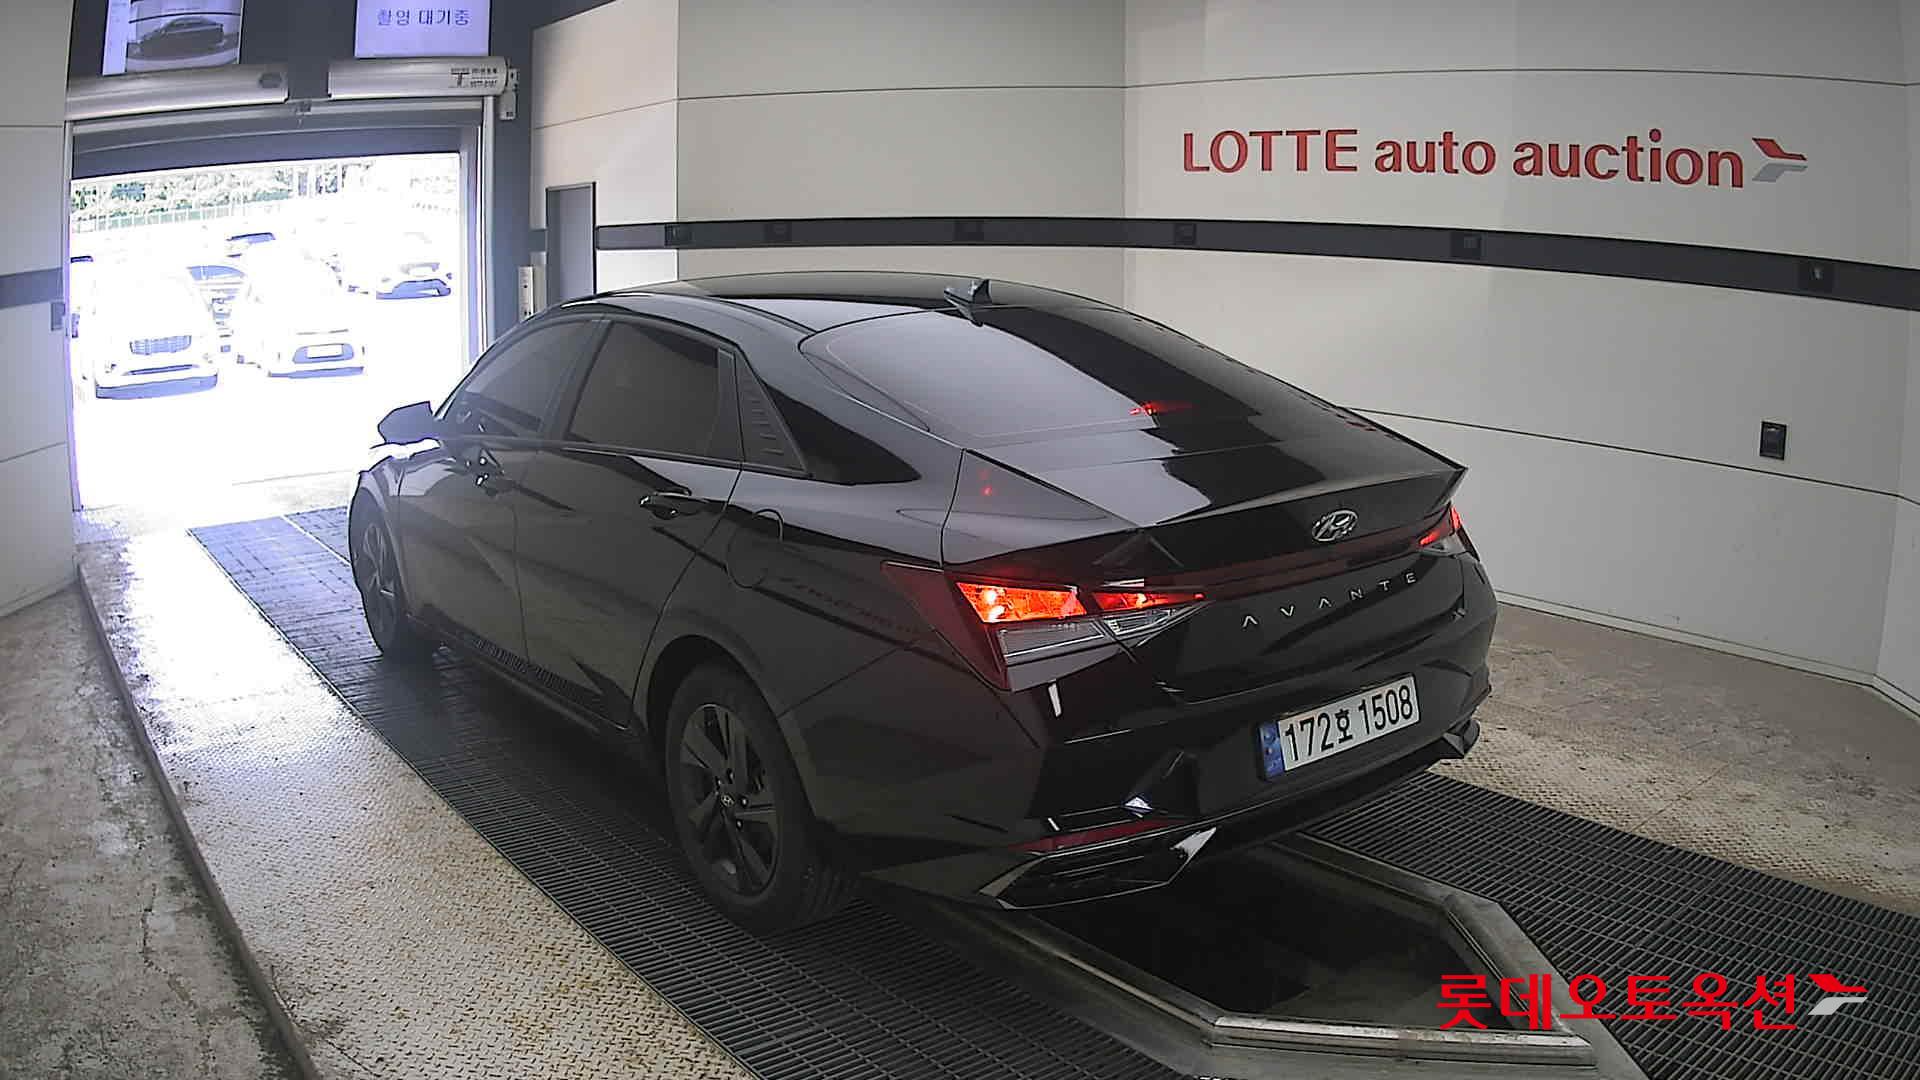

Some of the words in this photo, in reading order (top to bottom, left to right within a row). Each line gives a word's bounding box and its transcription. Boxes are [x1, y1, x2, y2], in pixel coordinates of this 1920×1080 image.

[418, 8, 469, 26] 대기중
[1183, 128, 1358, 173] LOTTE
[1375, 130, 1496, 175] auto
[1512, 128, 1744, 188] auction
[1241, 572, 1417, 628] AVANTE
[1285, 708, 1353, 762] 172호
[1358, 685, 1414, 735] 1508
